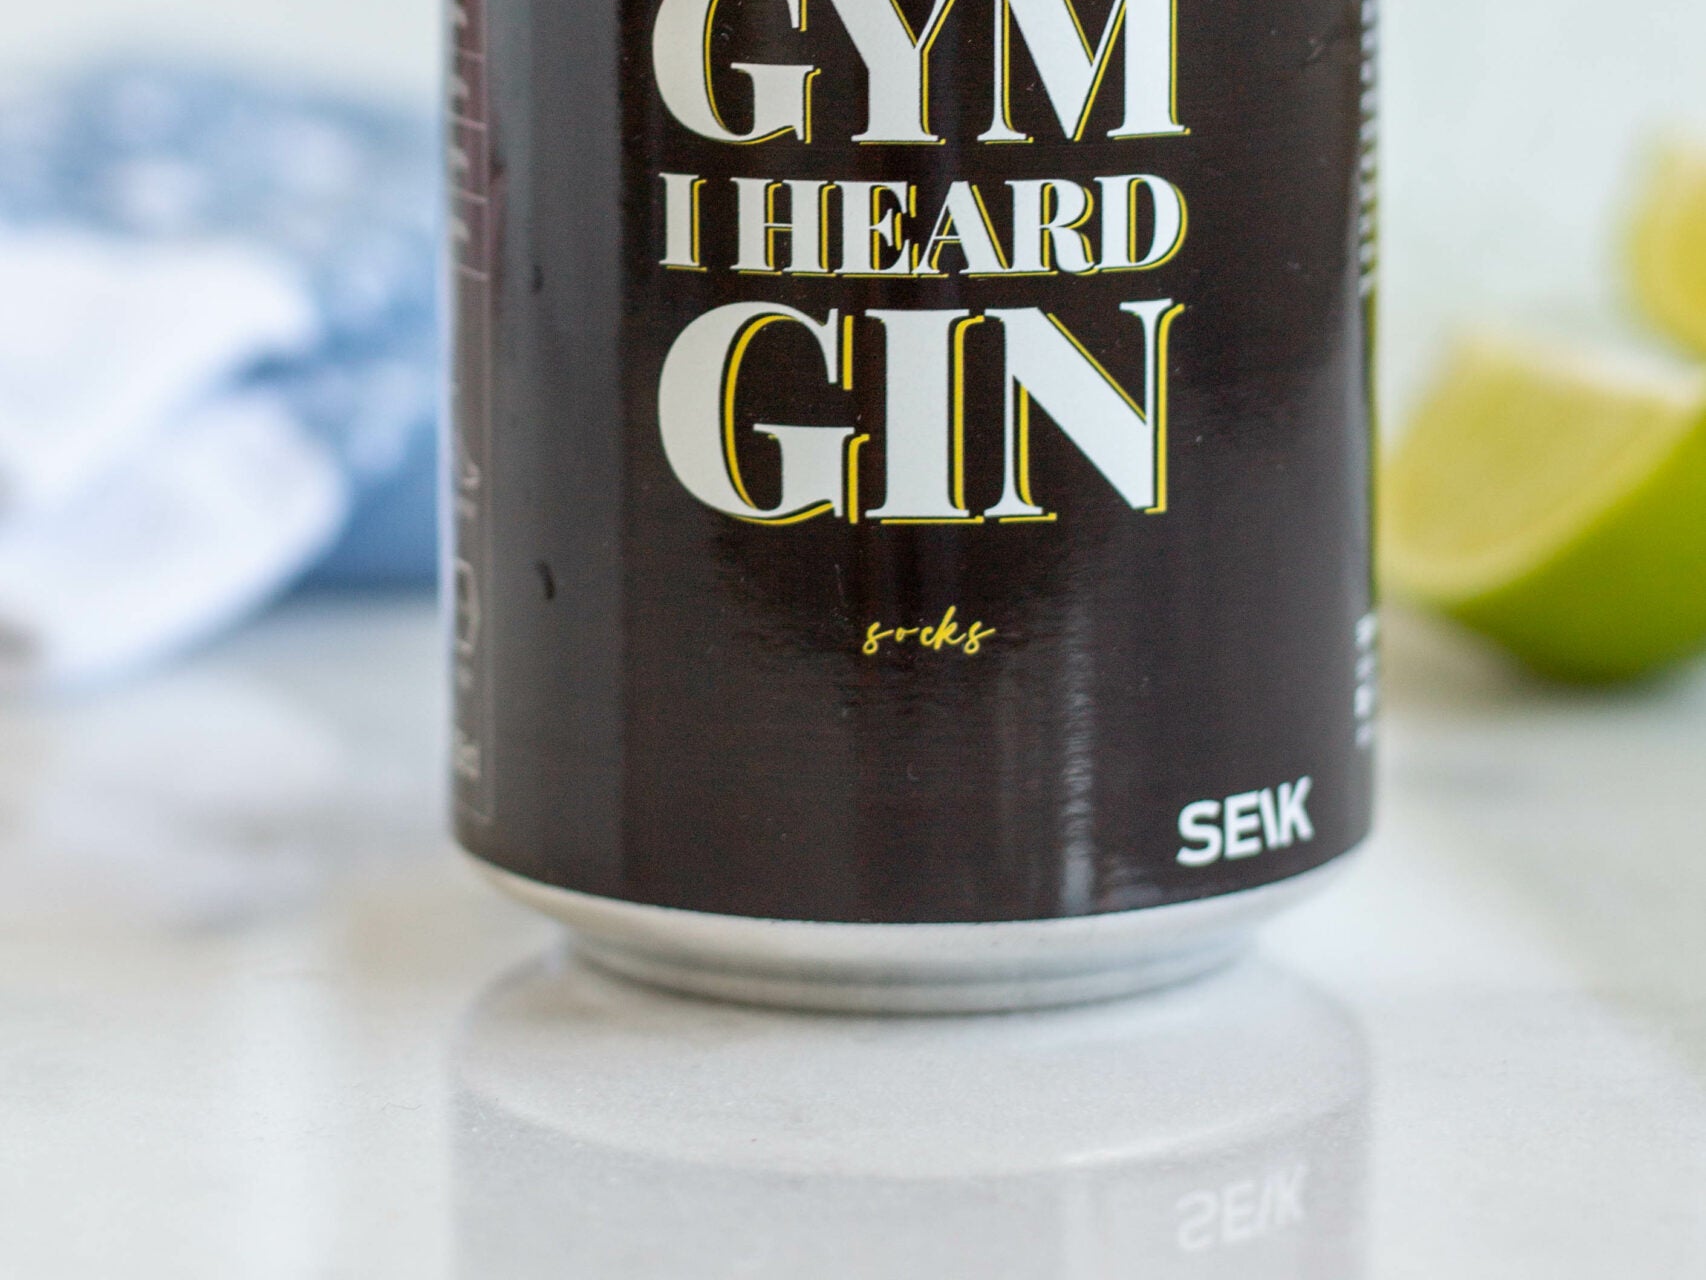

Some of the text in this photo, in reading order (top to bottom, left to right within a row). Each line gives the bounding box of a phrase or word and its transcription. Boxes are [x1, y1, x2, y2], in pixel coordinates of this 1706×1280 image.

[658, 172, 1189, 279] I HEARD
[657, 298, 1185, 526] GIN
[861, 606, 996, 656] socks
